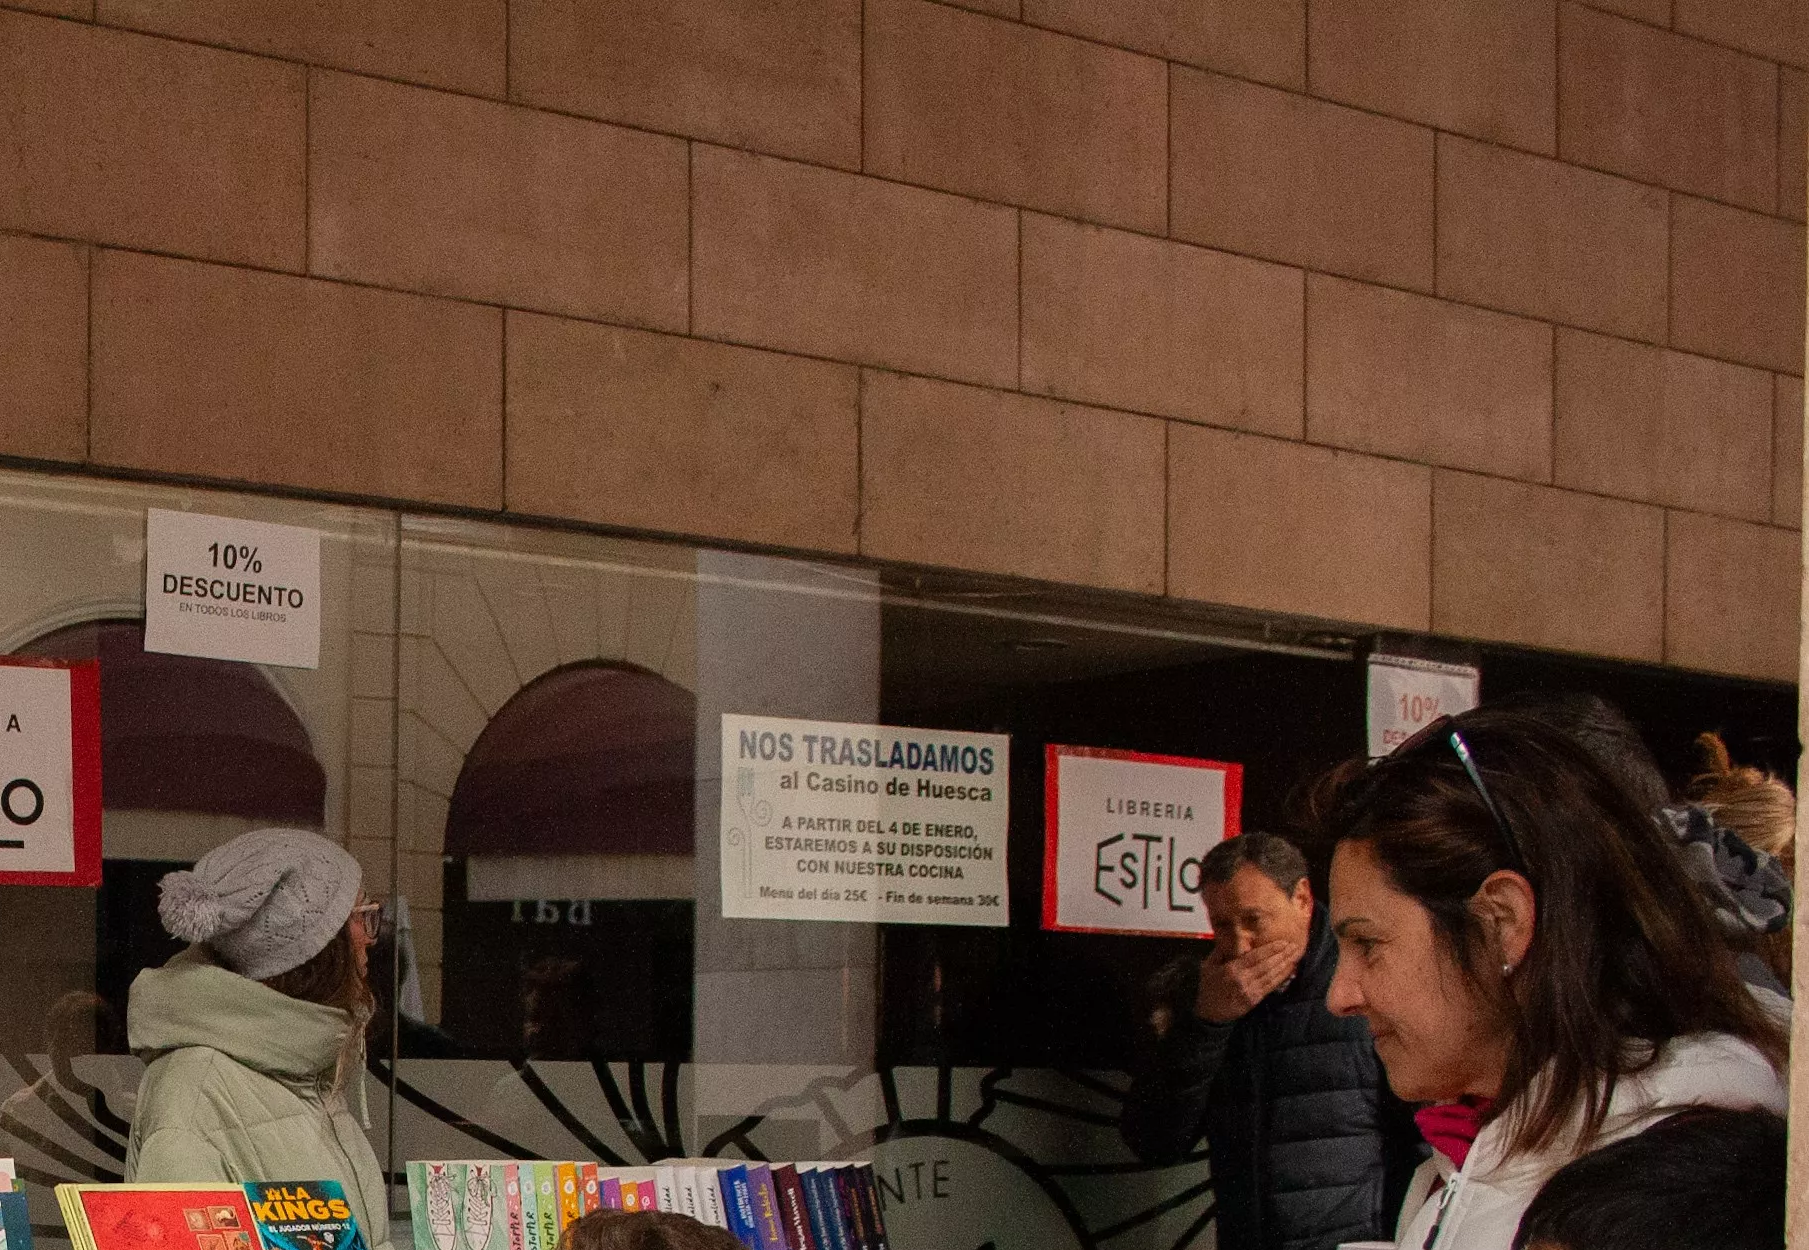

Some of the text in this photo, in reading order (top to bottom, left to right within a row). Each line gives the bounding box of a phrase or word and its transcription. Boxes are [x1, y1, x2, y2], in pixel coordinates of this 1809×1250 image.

[208, 542, 262, 573] 10%
[163, 573, 303, 608] DESCUENTO
[179, 603, 286, 623] EN TODOS LOS LIBROS
[740, 730, 995, 776] NOS TRASLADAMOS
[780, 771, 993, 802] al Casino de Huesca
[1106, 797, 1195, 822] LIBRERIA
[782, 816, 979, 841] A PARTIR DEL 4 DE ENERO,
[765, 835, 994, 862] ESTAREMOS A SU DISPOSICIÓN
[797, 858, 966, 880] CON NUESTRA COCINA
[797, 886, 818, 900] del
[885, 891, 905, 905] Fin
[908, 893, 924, 906] de
[927, 895, 975, 908] semana
[252, 1199, 351, 1223] KINGS
